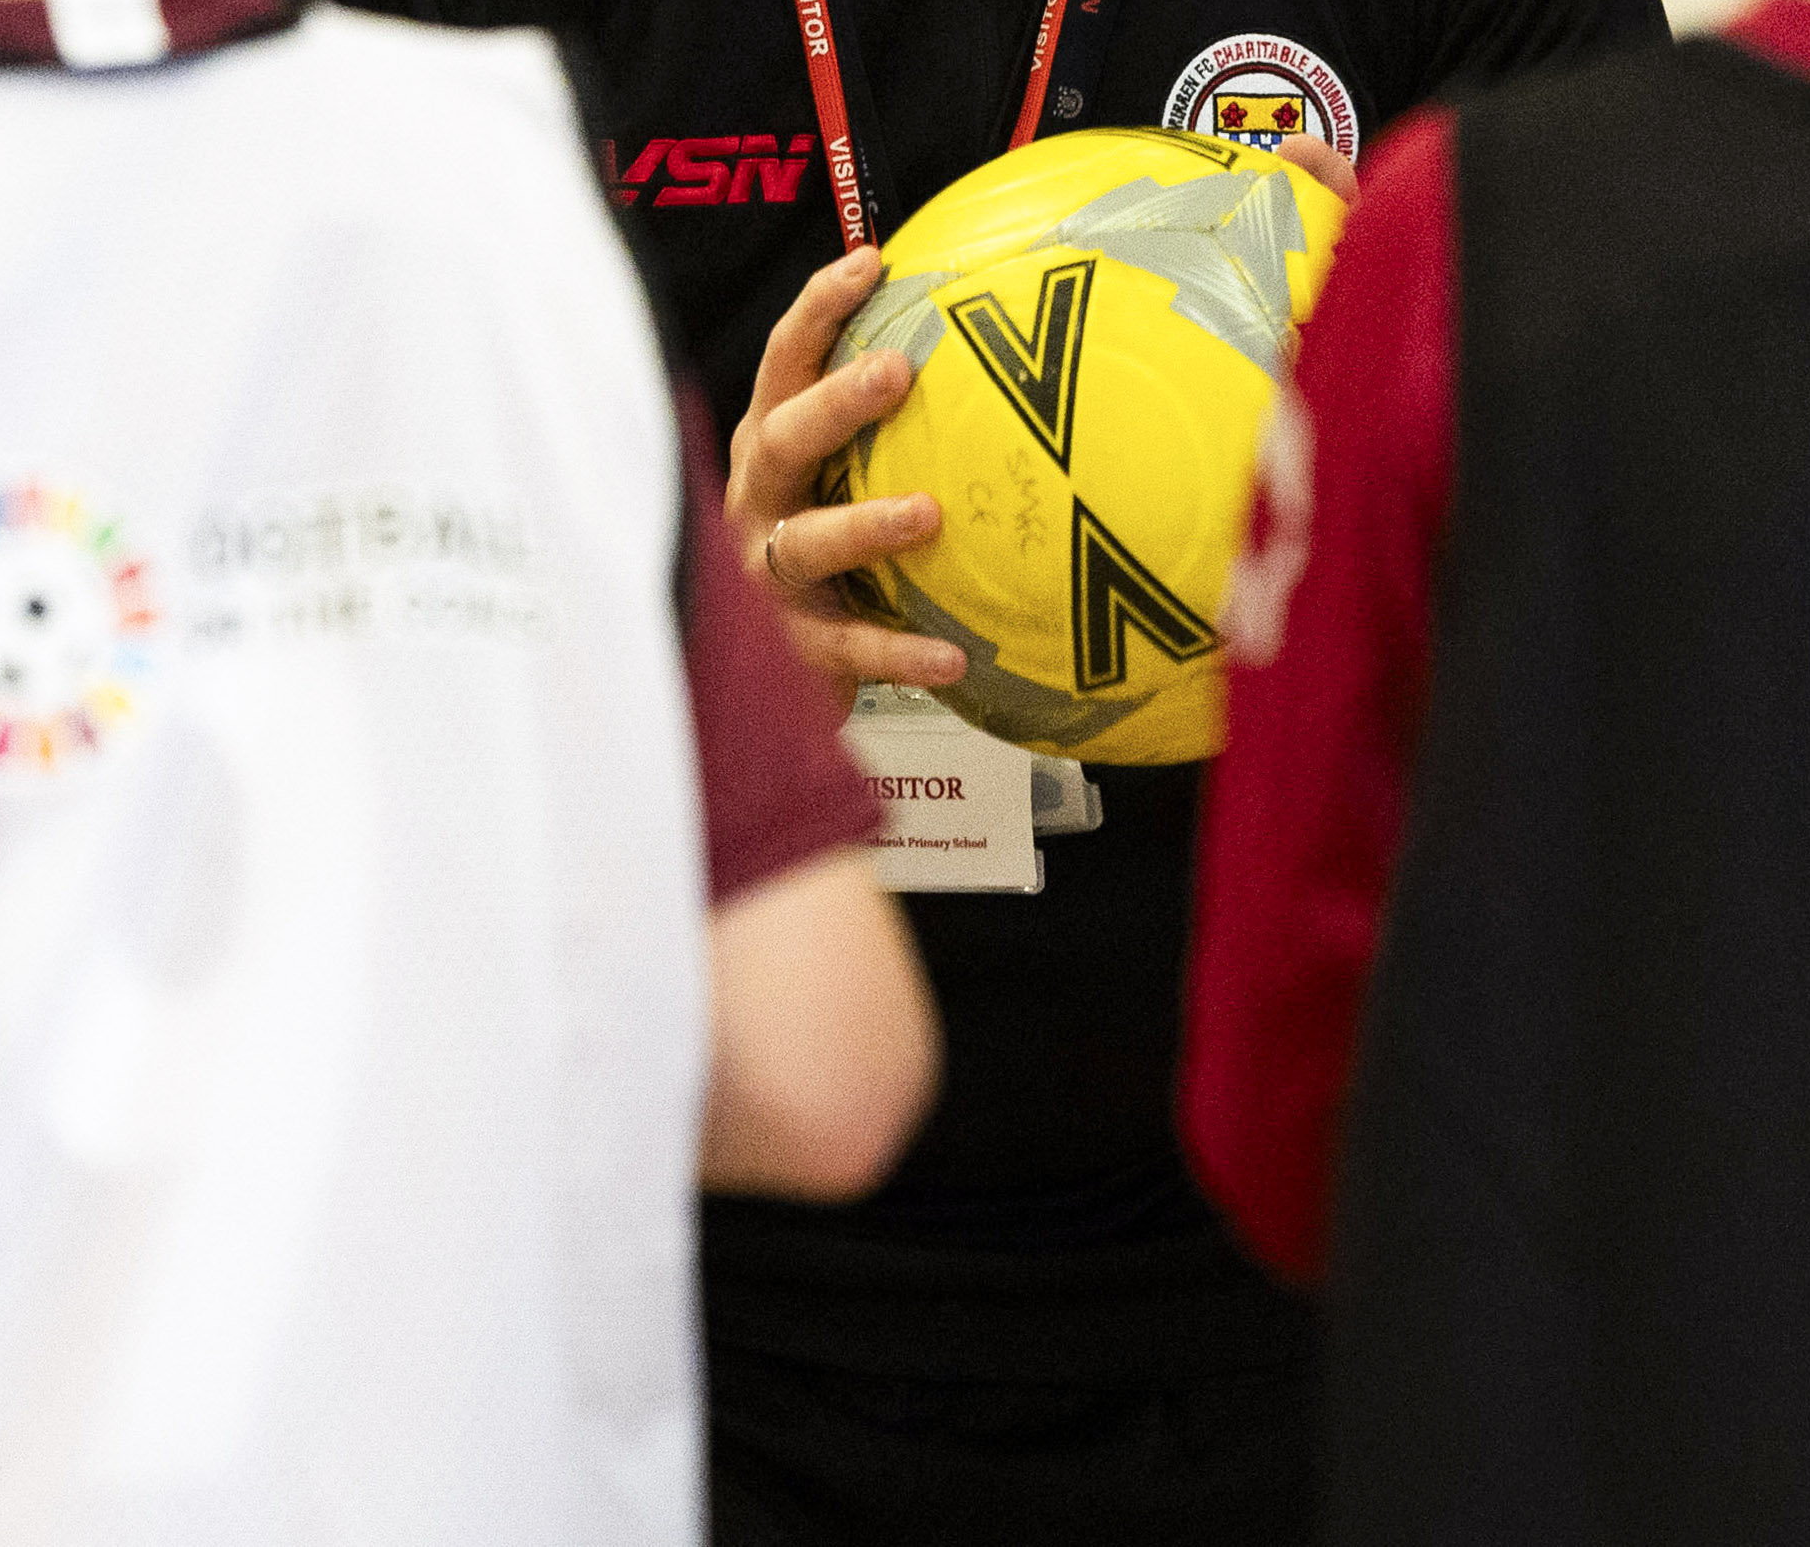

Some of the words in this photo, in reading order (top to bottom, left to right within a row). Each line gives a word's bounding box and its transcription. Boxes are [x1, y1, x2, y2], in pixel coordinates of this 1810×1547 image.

[1194, 58, 1214, 79] FC
[1212, 40, 1310, 72] CHARITABLE
[829, 136, 865, 242] VISITOR
[908, 836, 951, 852] Primary
